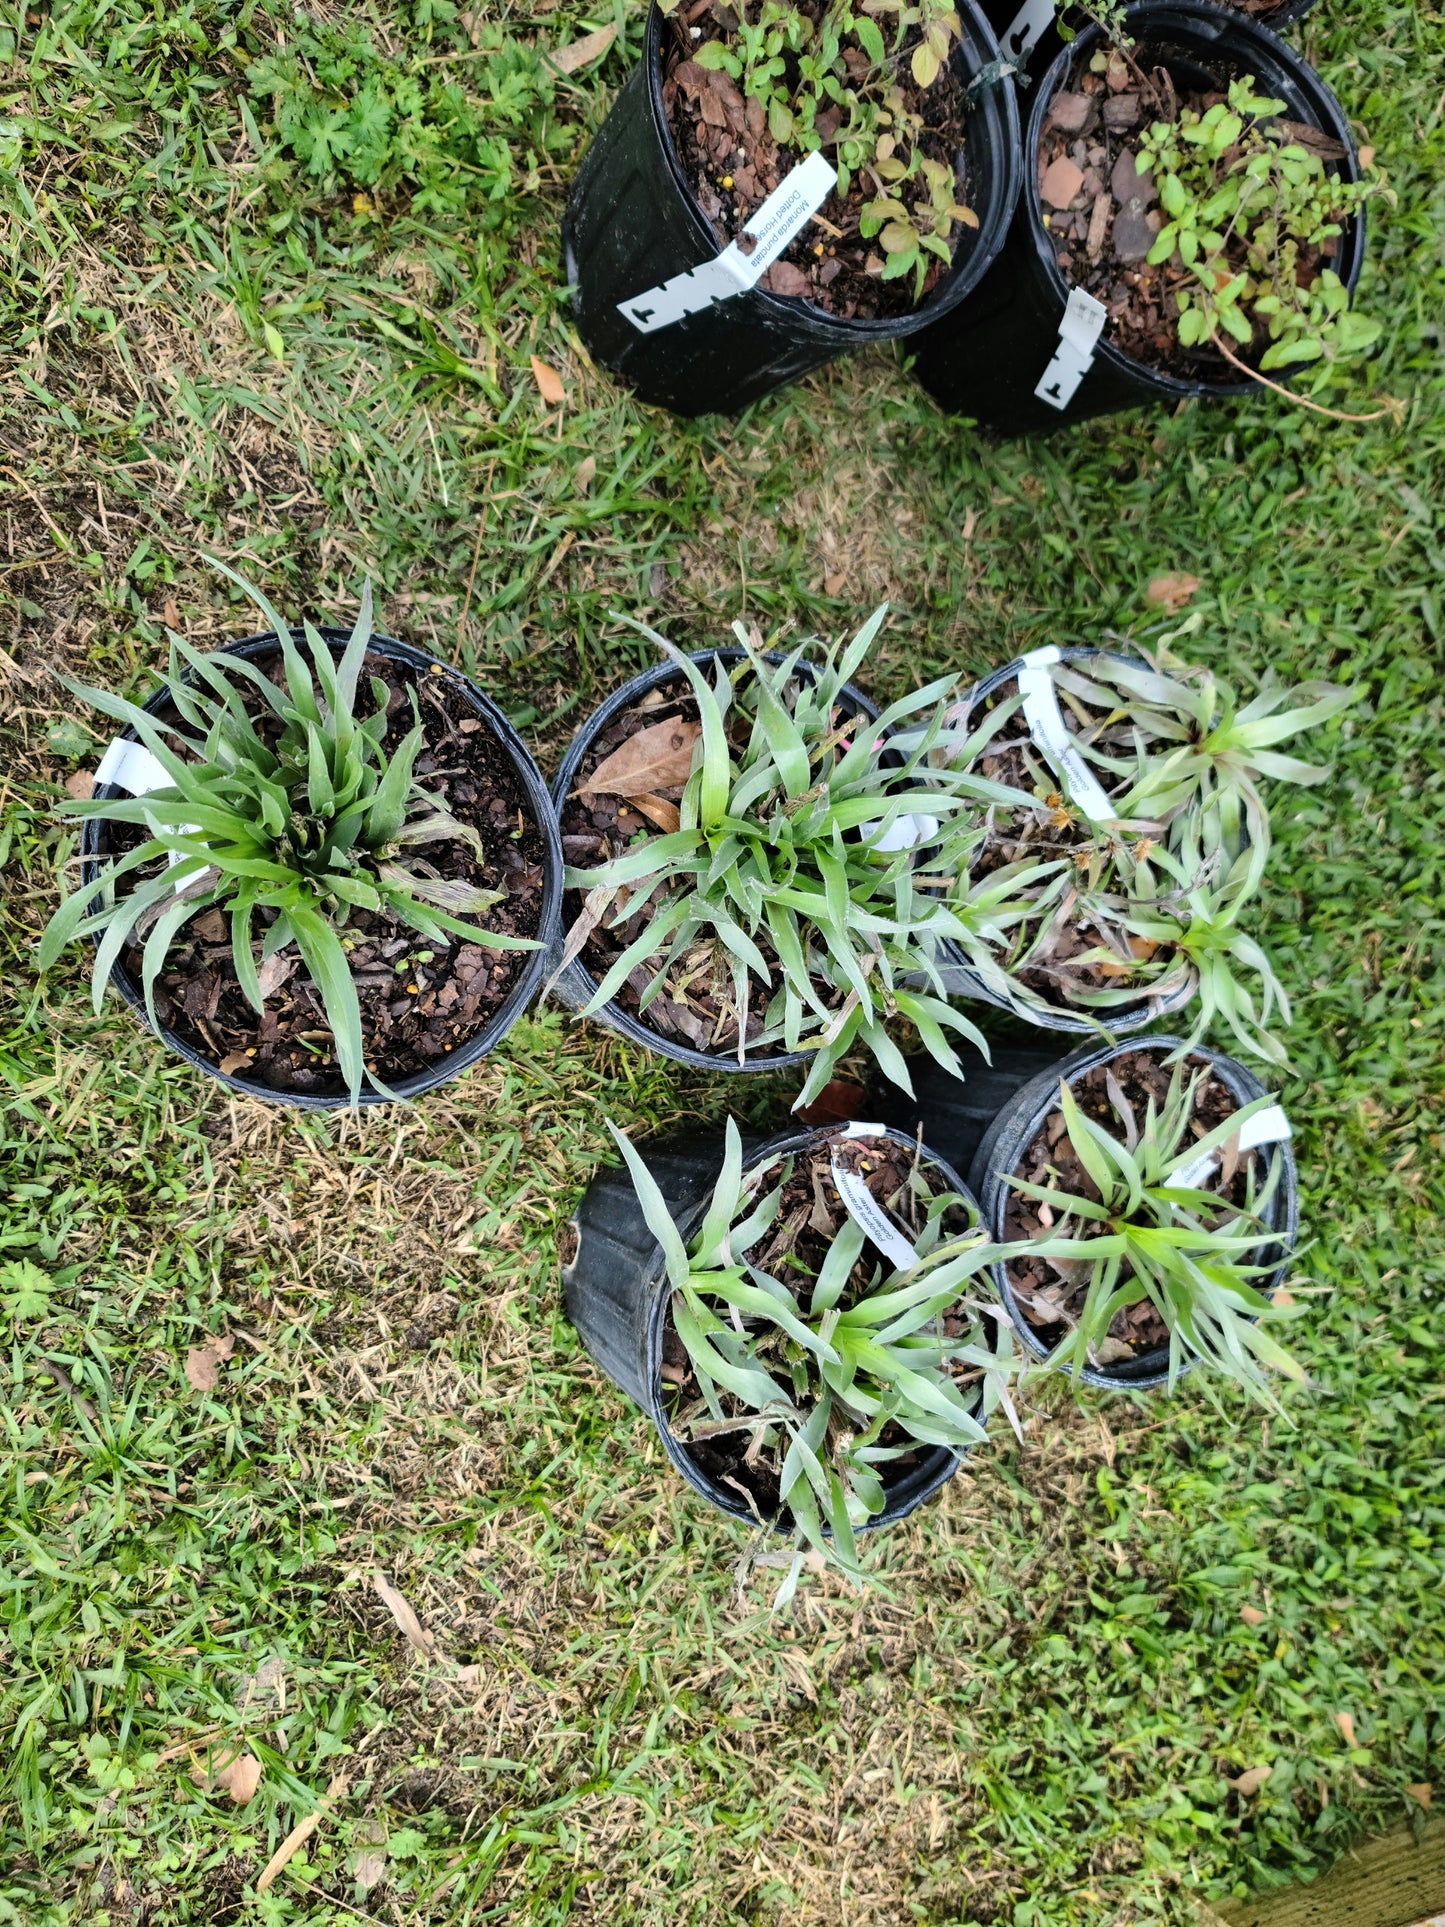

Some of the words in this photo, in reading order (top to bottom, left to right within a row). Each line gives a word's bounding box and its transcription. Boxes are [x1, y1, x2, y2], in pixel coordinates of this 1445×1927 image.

[776, 189, 802, 221] Dotted
[777, 199, 810, 236] Monarda
[750, 234, 779, 268] punctata
